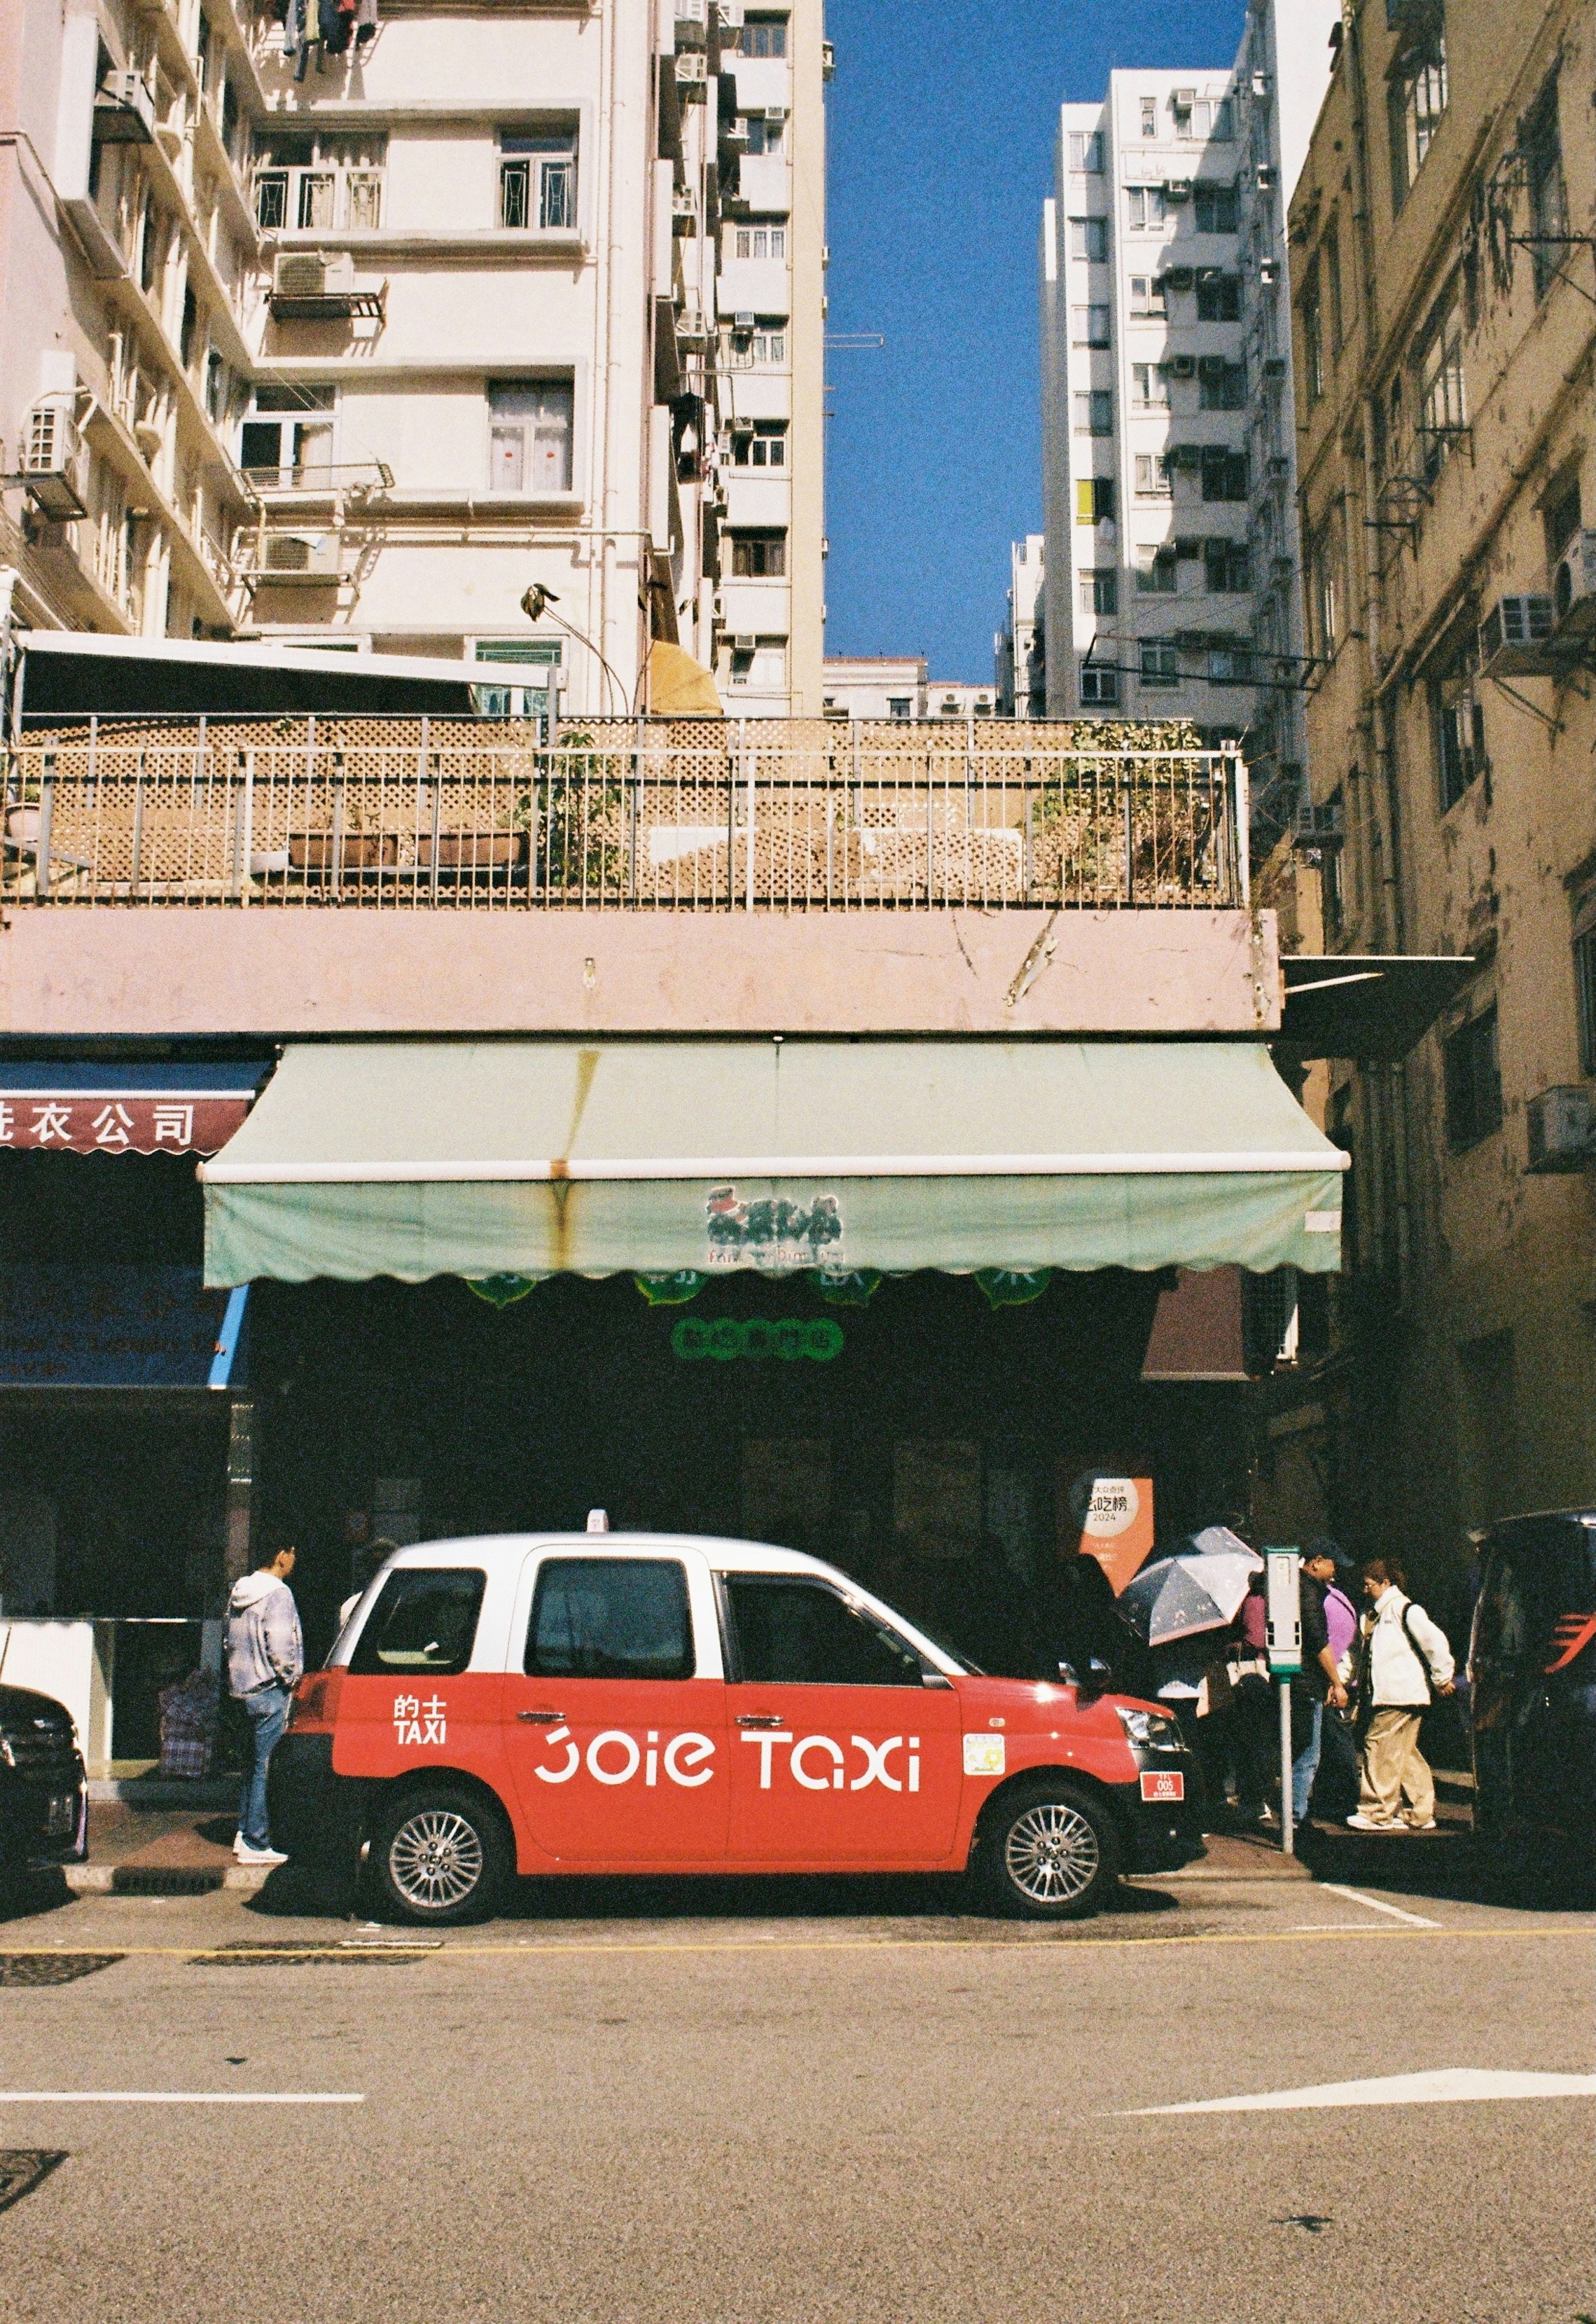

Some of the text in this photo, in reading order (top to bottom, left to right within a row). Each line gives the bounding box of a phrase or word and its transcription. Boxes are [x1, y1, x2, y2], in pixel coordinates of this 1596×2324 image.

[1093, 1513, 1116, 1521] 2024
[394, 1694, 447, 1719] 的士
[393, 1720, 447, 1745] TAXI
[740, 1730, 920, 1792] Taxi
[1157, 1780, 1174, 1792] 005
